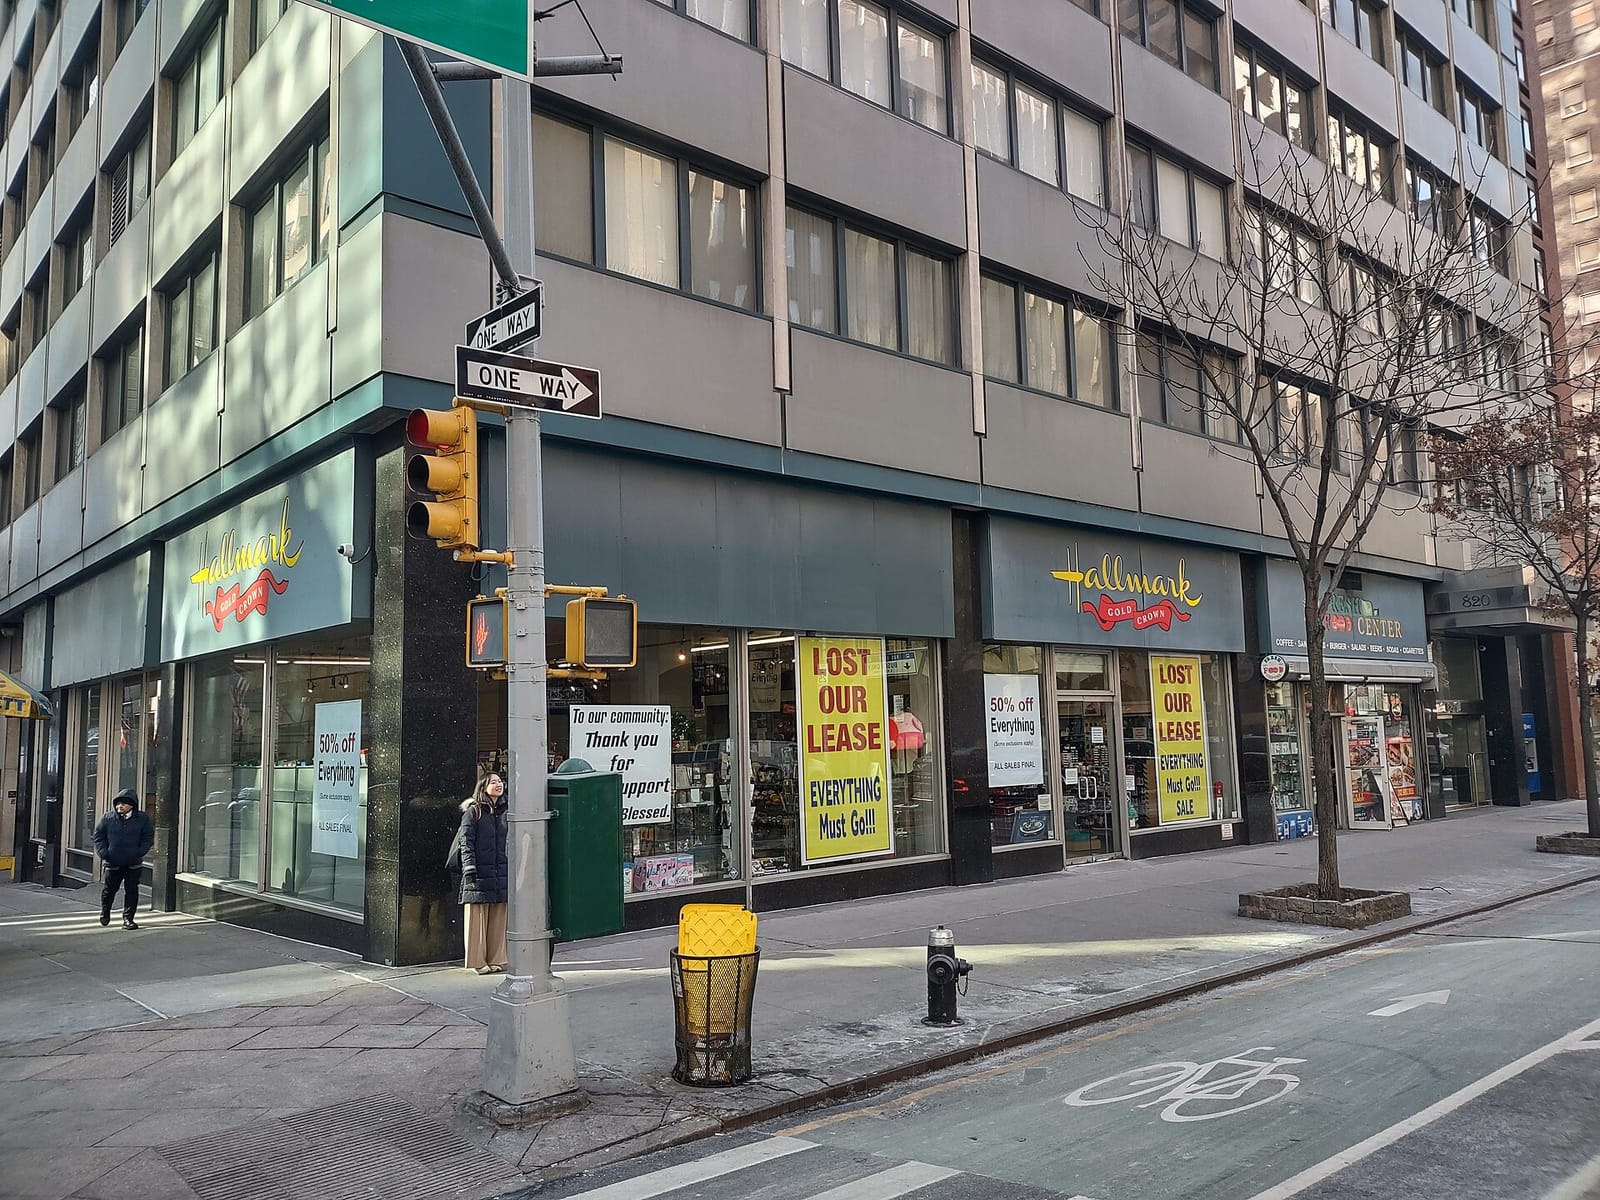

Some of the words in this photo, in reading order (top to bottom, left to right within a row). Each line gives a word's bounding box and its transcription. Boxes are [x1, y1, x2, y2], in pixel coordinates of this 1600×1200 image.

[477, 325, 497, 349] ONE
[507, 308, 531, 336] WAY
[479, 366, 521, 390] ONE
[540, 376, 580, 399] WAY
[190, 496, 304, 618] Hallmark
[1050, 540, 1203, 614] Hallmark
[220, 594, 236, 612] GOLD
[238, 586, 263, 615] CROWN
[1462, 595, 1490, 608] 820
[1107, 605, 1132, 617] GOLD
[1136, 609, 1165, 625] CROWN
[1357, 617, 1402, 639] CENTER
[1276, 638, 1294, 647] COFFEE
[812, 647, 871, 676] LOST
[1159, 664, 1193, 685] LOST
[819, 685, 867, 713] OUR
[990, 697, 1015, 712] 50%
[1018, 697, 1034, 712] off
[1164, 692, 1192, 713] OUR
[573, 708, 585, 724] To
[588, 711, 607, 724] our
[610, 708, 669, 727] community:
[991, 717, 1035, 736] Everything
[586, 731, 630, 748] Thank
[634, 734, 659, 750] you
[807, 722, 881, 753] LEASE
[1158, 721, 1201, 742] LEASE
[319, 733, 339, 753] 50%
[341, 732, 356, 753] off
[610, 754, 635, 771] for
[994, 762, 1004, 770] ALL
[1004, 761, 1020, 769] SALES
[1160, 752, 1203, 771] EVERYTHING
[318, 760, 355, 787] Everything
[1166, 778, 1183, 793] Must
[1185, 775, 1201, 792] Go!!!
[621, 778, 671, 798] upport
[810, 775, 882, 808] EVERYTHING
[622, 804, 670, 820] Blessed.
[1176, 800, 1194, 817] SALE
[326, 822, 339, 832] SALES
[339, 823, 353, 833] FINAL
[819, 813, 847, 840] Must
[851, 808, 876, 836] Go!!!
